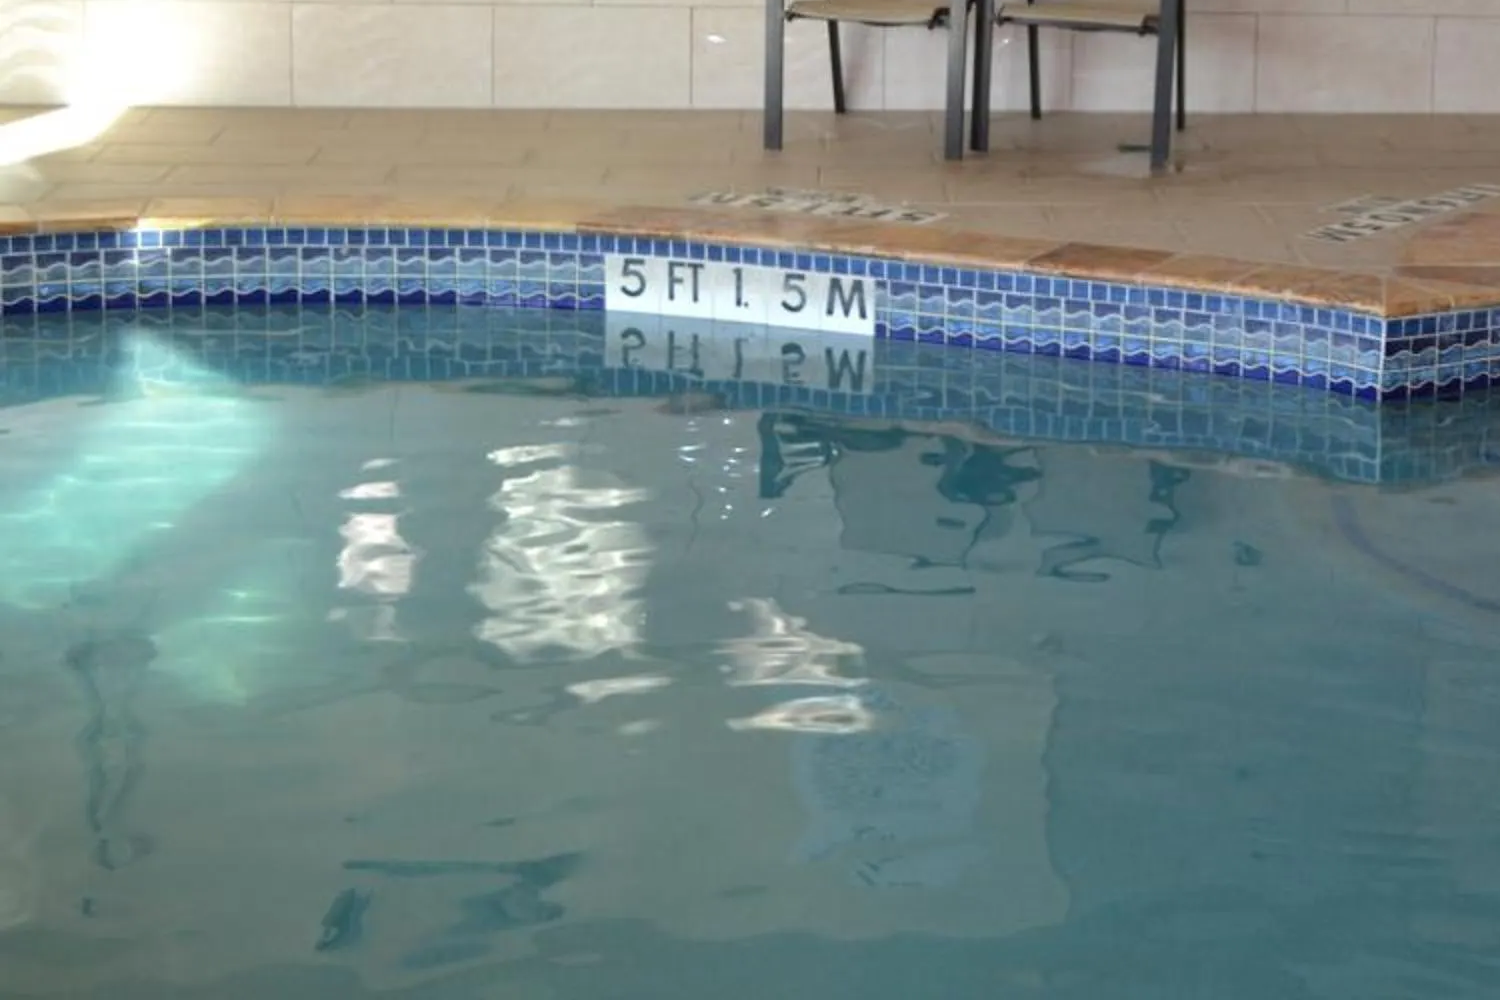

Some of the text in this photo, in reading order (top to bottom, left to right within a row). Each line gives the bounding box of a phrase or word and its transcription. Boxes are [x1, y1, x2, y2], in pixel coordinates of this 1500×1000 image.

[620, 258, 647, 298] 5
[667, 261, 704, 303] FT
[826, 277, 868, 320] M
